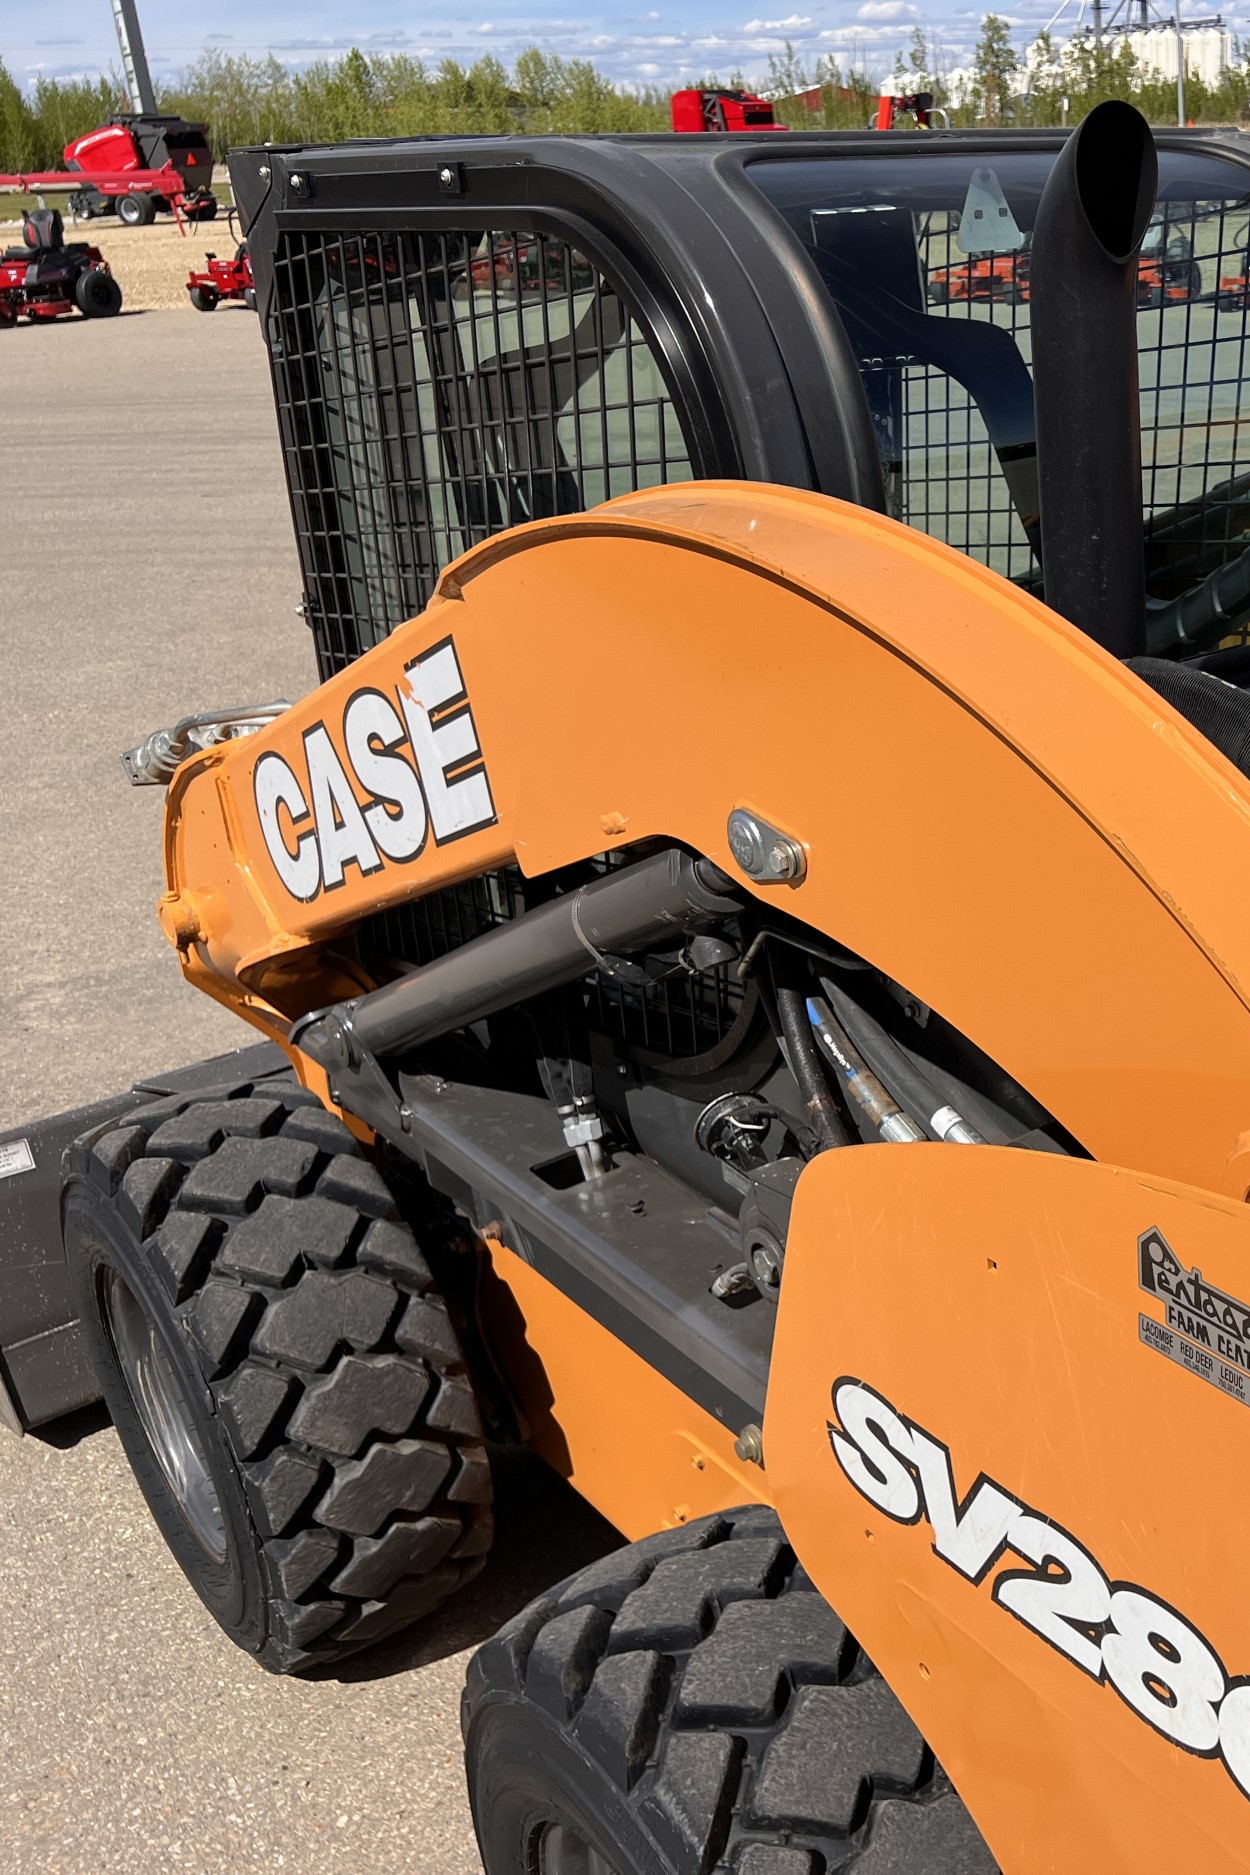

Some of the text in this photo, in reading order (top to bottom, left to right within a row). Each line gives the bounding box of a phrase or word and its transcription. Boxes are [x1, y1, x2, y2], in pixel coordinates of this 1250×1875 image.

[252, 633, 498, 904] CASE
[1141, 1318, 1174, 1348] LACOMBE
[1180, 1341, 1194, 1360] RED
[1195, 1350, 1214, 1372] DEER
[1220, 1365, 1243, 1390] LEDUC
[1168, 1305, 1212, 1347] FARM
